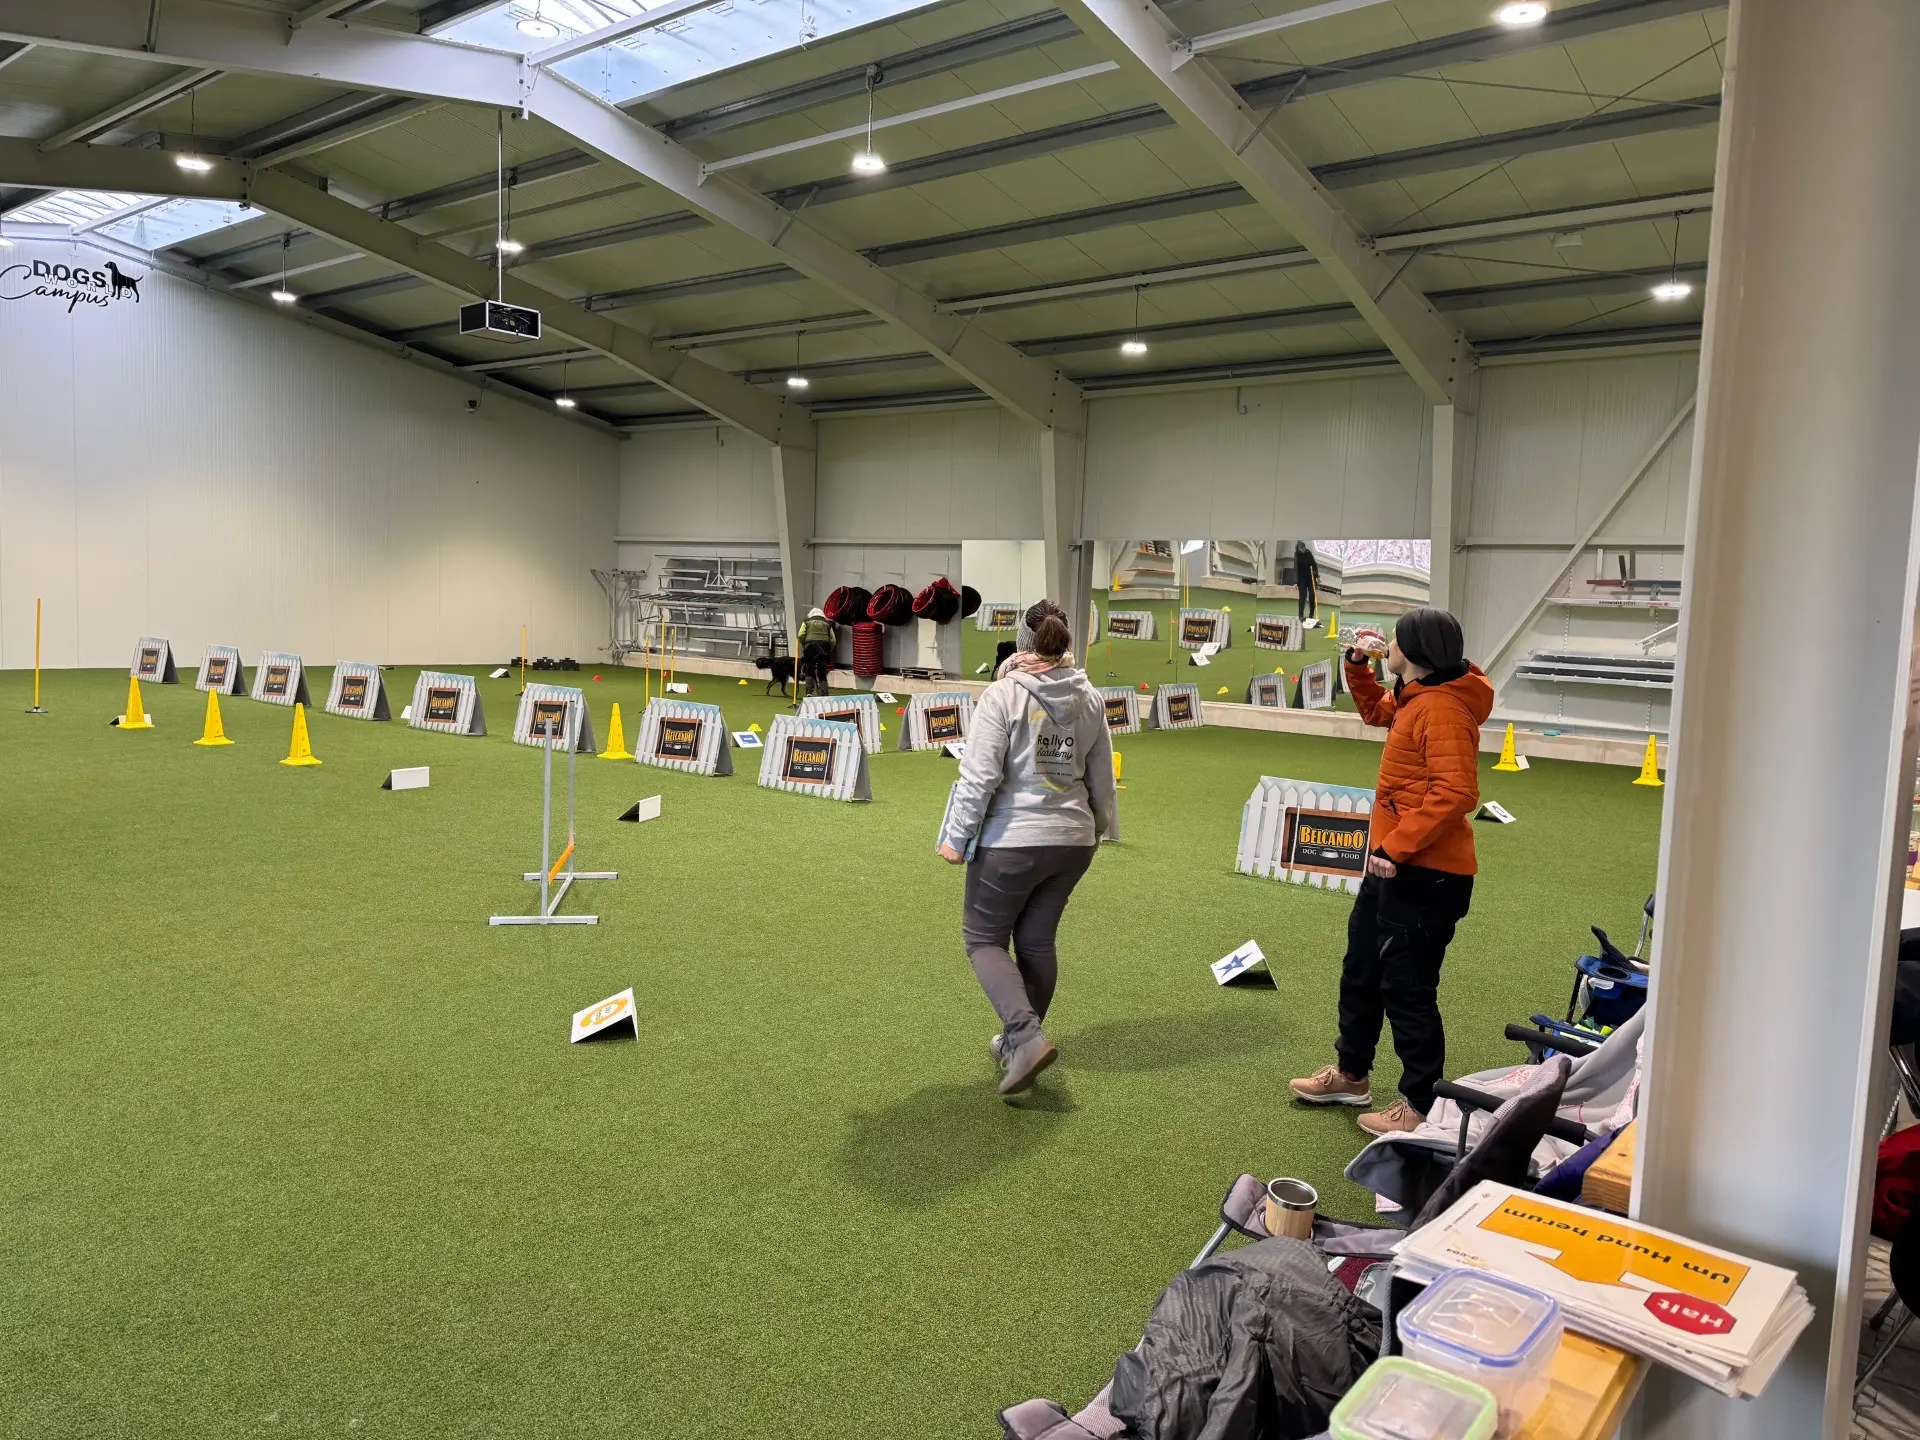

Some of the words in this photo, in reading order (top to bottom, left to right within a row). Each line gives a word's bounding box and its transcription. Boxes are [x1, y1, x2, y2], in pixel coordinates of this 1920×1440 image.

[33, 259, 107, 288] DOGS
[0, 264, 109, 314] Campus
[1299, 825, 1366, 850] BELCANDO
[1503, 1207, 1589, 1237] herum
[1596, 1233, 1673, 1264] Hund
[1682, 1261, 1731, 1285] Um
[1657, 1298, 1725, 1329] Halt
